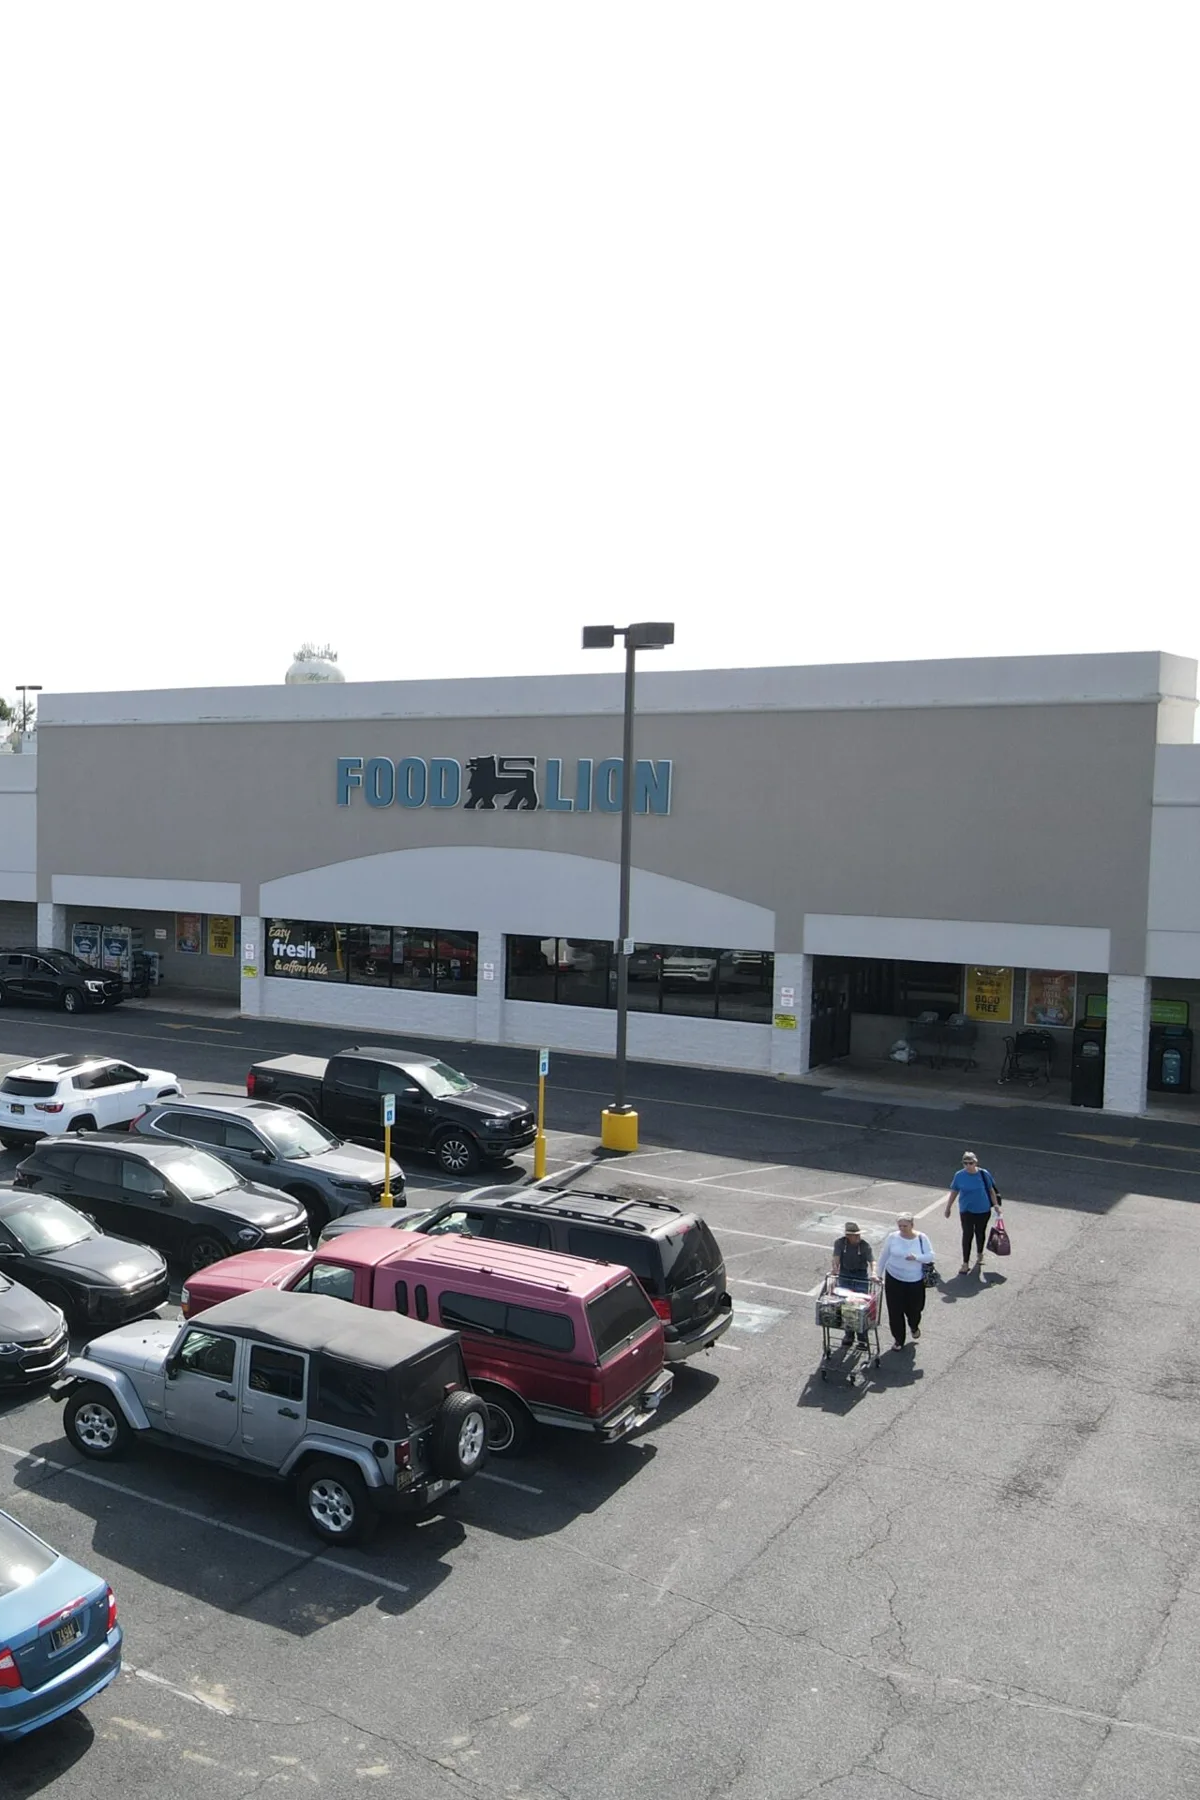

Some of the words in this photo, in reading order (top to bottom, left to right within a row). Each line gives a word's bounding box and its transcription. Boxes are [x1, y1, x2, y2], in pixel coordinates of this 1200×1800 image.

[337, 756, 461, 808] FOOD
[545, 757, 673, 815] LION
[268, 926, 292, 944] Easy
[272, 938, 316, 959] fresh
[274, 959, 282, 970] &
[975, 1003, 999, 1013] FREE
